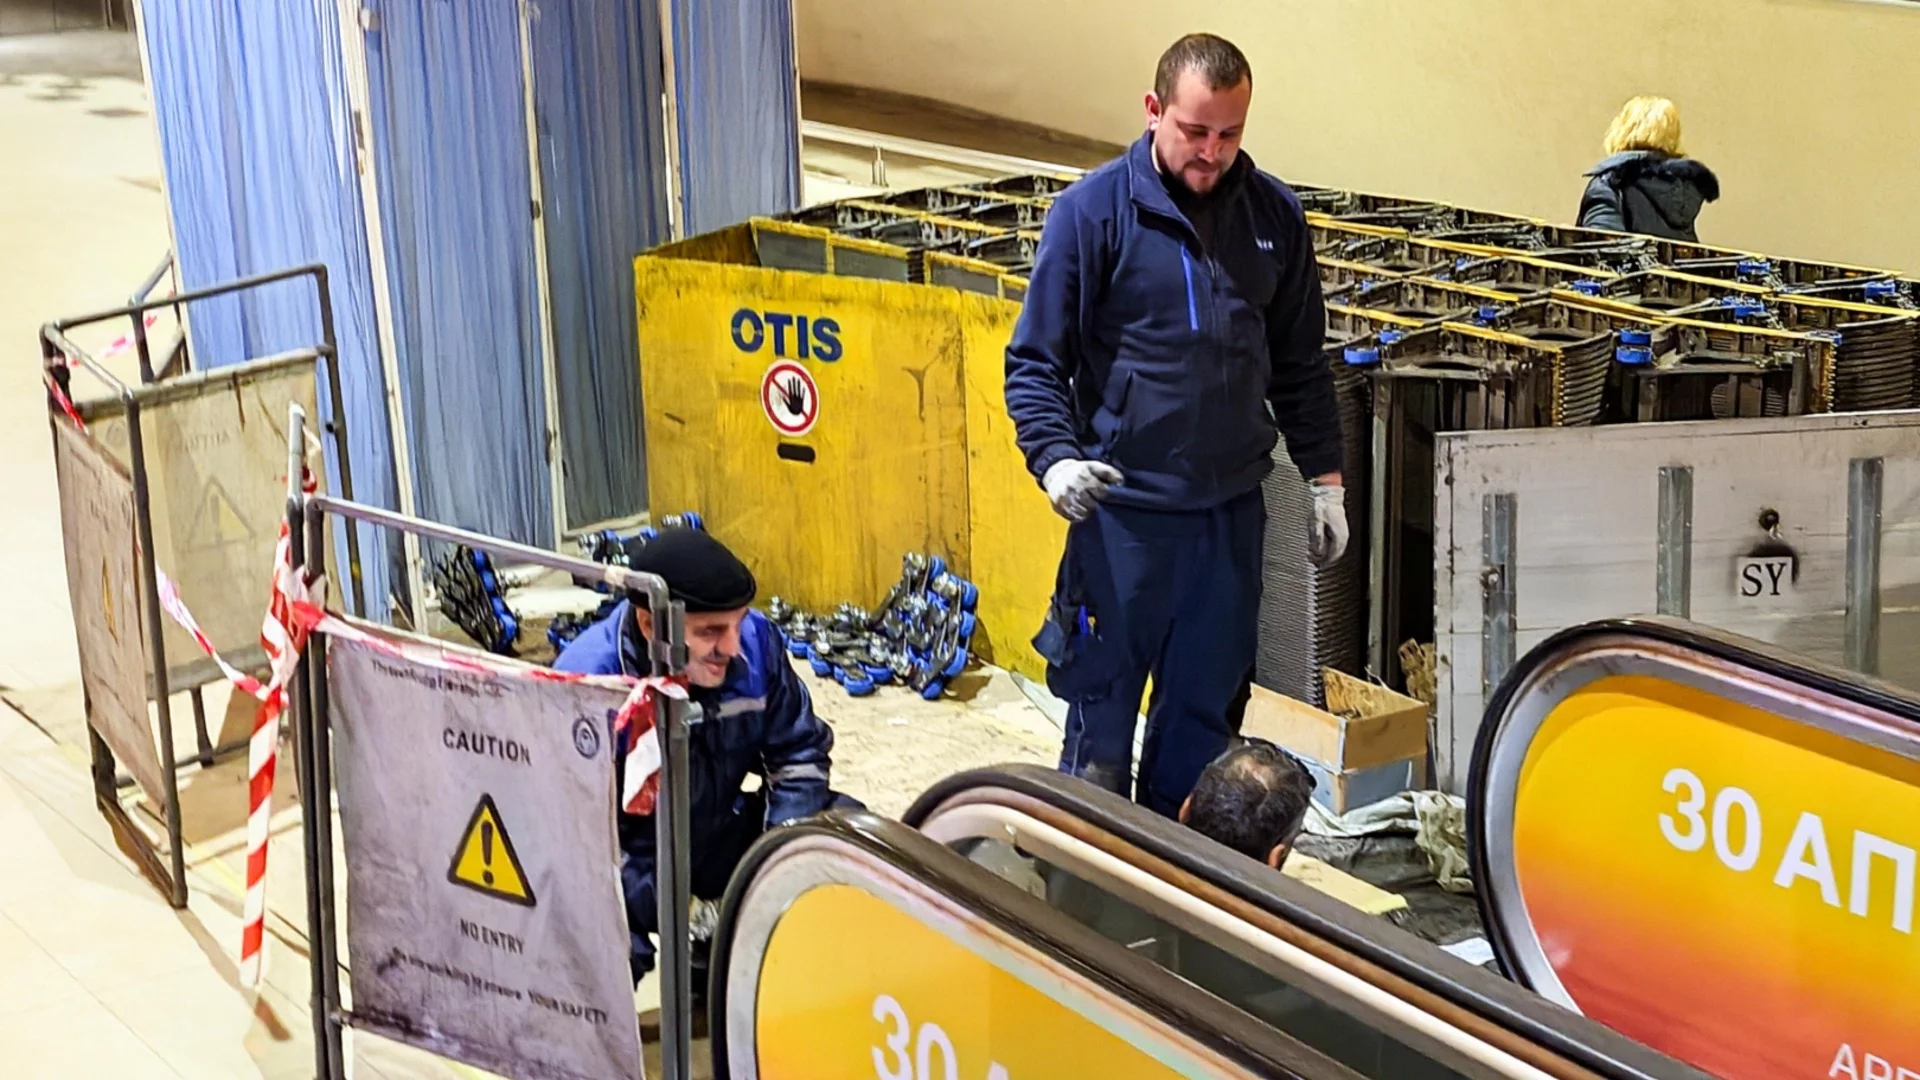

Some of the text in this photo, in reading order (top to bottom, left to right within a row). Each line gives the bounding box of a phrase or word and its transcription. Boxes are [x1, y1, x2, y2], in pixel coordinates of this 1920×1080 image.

[731, 308, 843, 363] OTIS
[1741, 562, 1787, 597] SY
[443, 728, 532, 766] CAUTION
[1658, 768, 1917, 935] 30 АП
[460, 918, 524, 955] NO ENTRY
[871, 993, 958, 1080] 30
